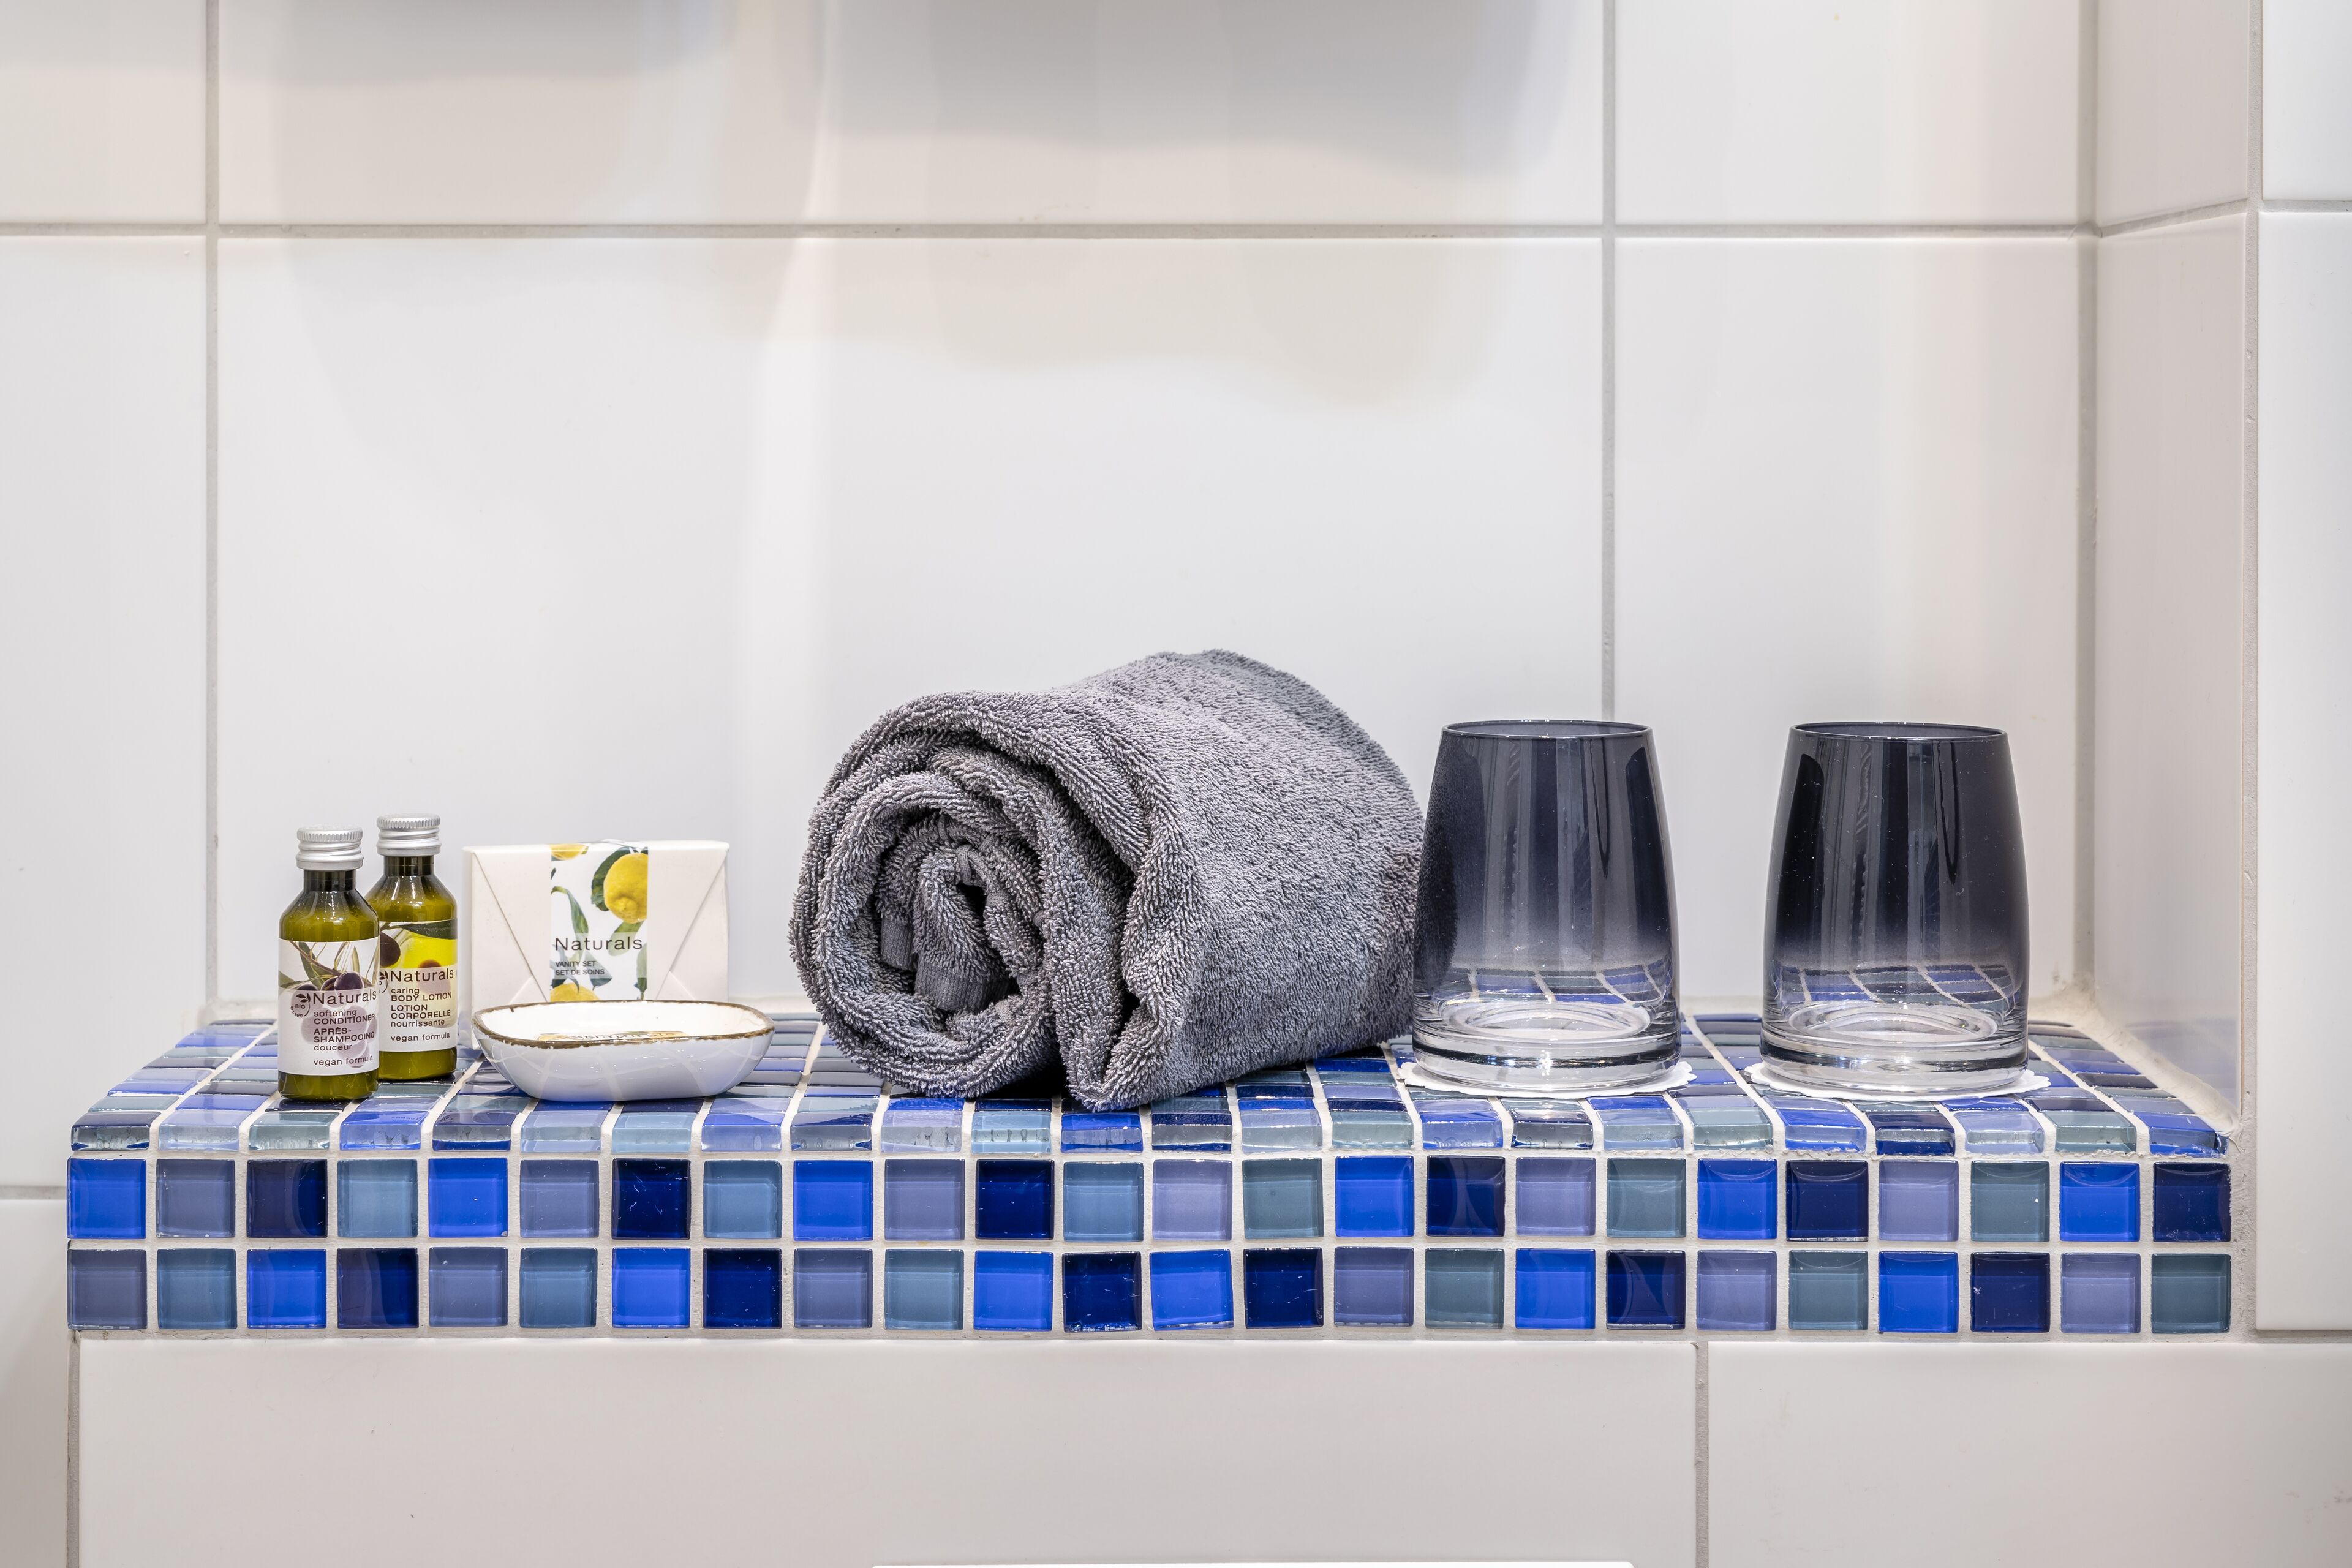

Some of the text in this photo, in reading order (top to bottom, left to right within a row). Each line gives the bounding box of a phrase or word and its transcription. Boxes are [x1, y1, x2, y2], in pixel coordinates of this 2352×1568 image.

[555, 936, 643, 951] Naturals
[391, 968, 454, 982] Naturals
[313, 990, 377, 1005] Naturals
[423, 992, 451, 1000] LOTION
[290, 1006, 303, 1018] OLIVE
[391, 1010, 451, 1019] CORPORELLE
[314, 1013, 375, 1025] CONDITIONER
[314, 1031, 375, 1042] SHAMPOOING
[422, 1032, 450, 1041] formula
[345, 1055, 373, 1064] formula
